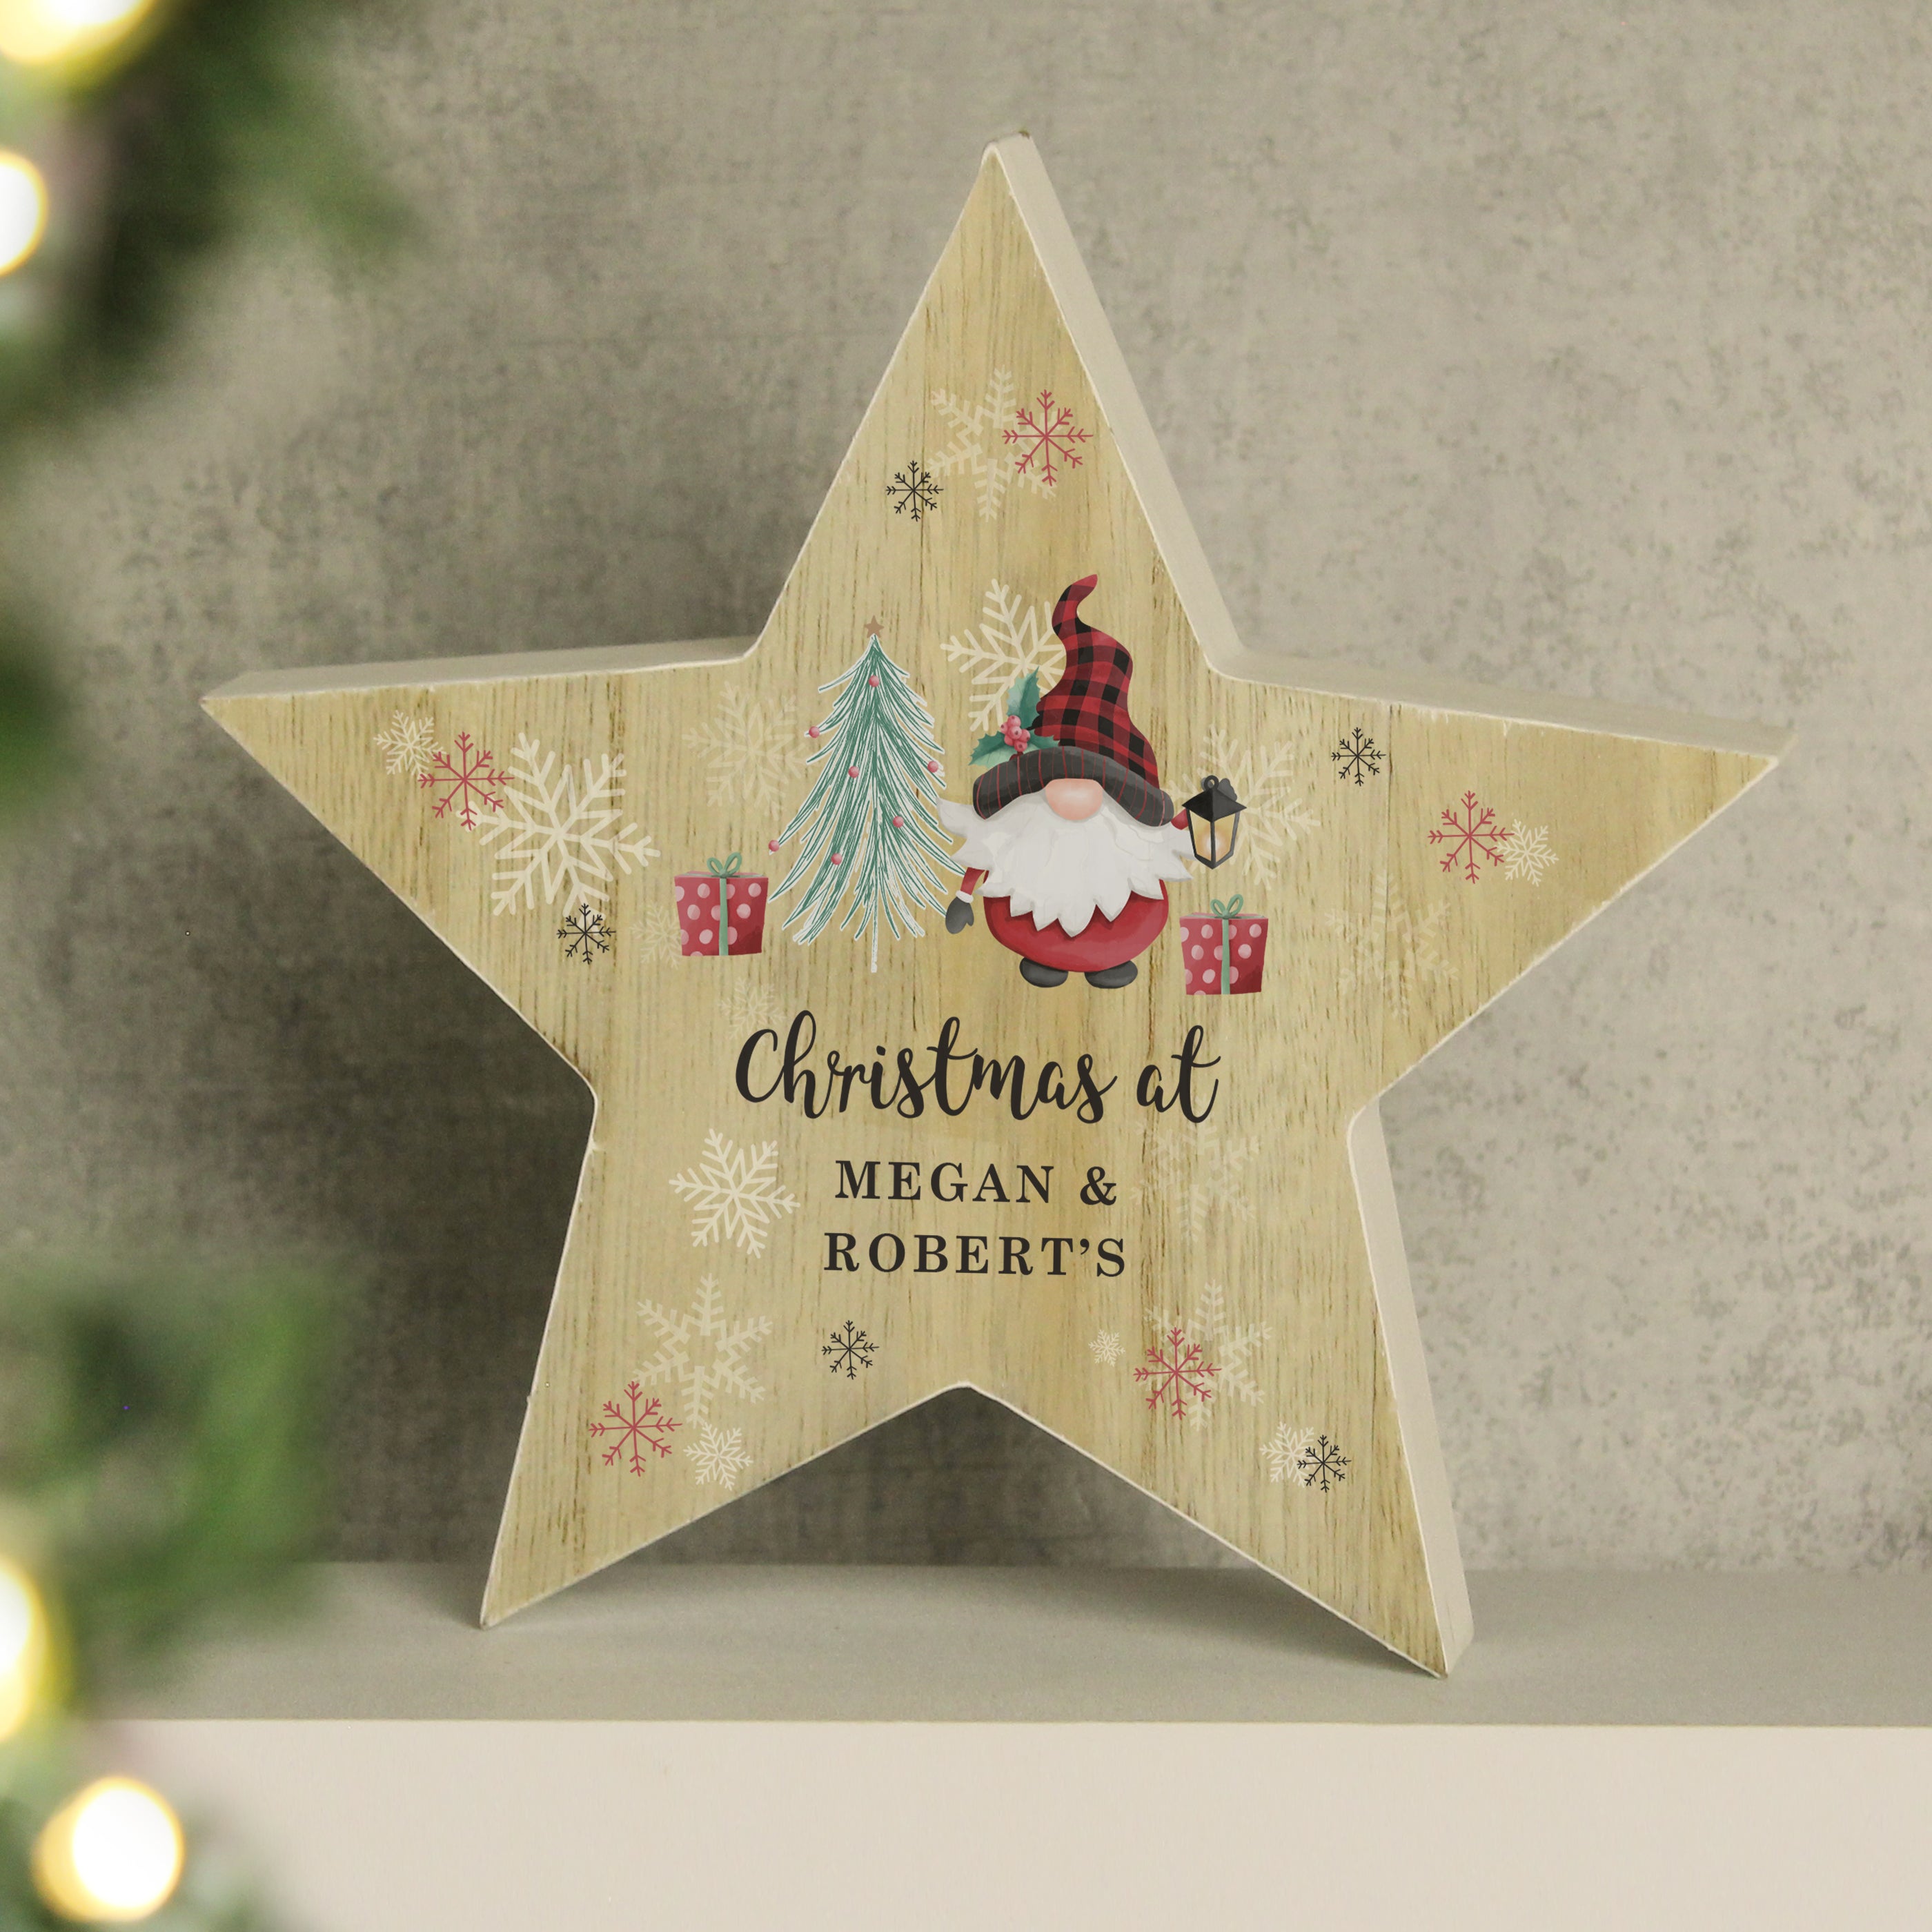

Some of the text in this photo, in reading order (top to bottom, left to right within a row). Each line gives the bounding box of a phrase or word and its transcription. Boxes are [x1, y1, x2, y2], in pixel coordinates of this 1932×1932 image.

[736, 1009, 1221, 1124] Christmas at
[835, 1160, 1118, 1206] MEGAN &
[824, 1232, 1125, 1277] ROBERT’S
